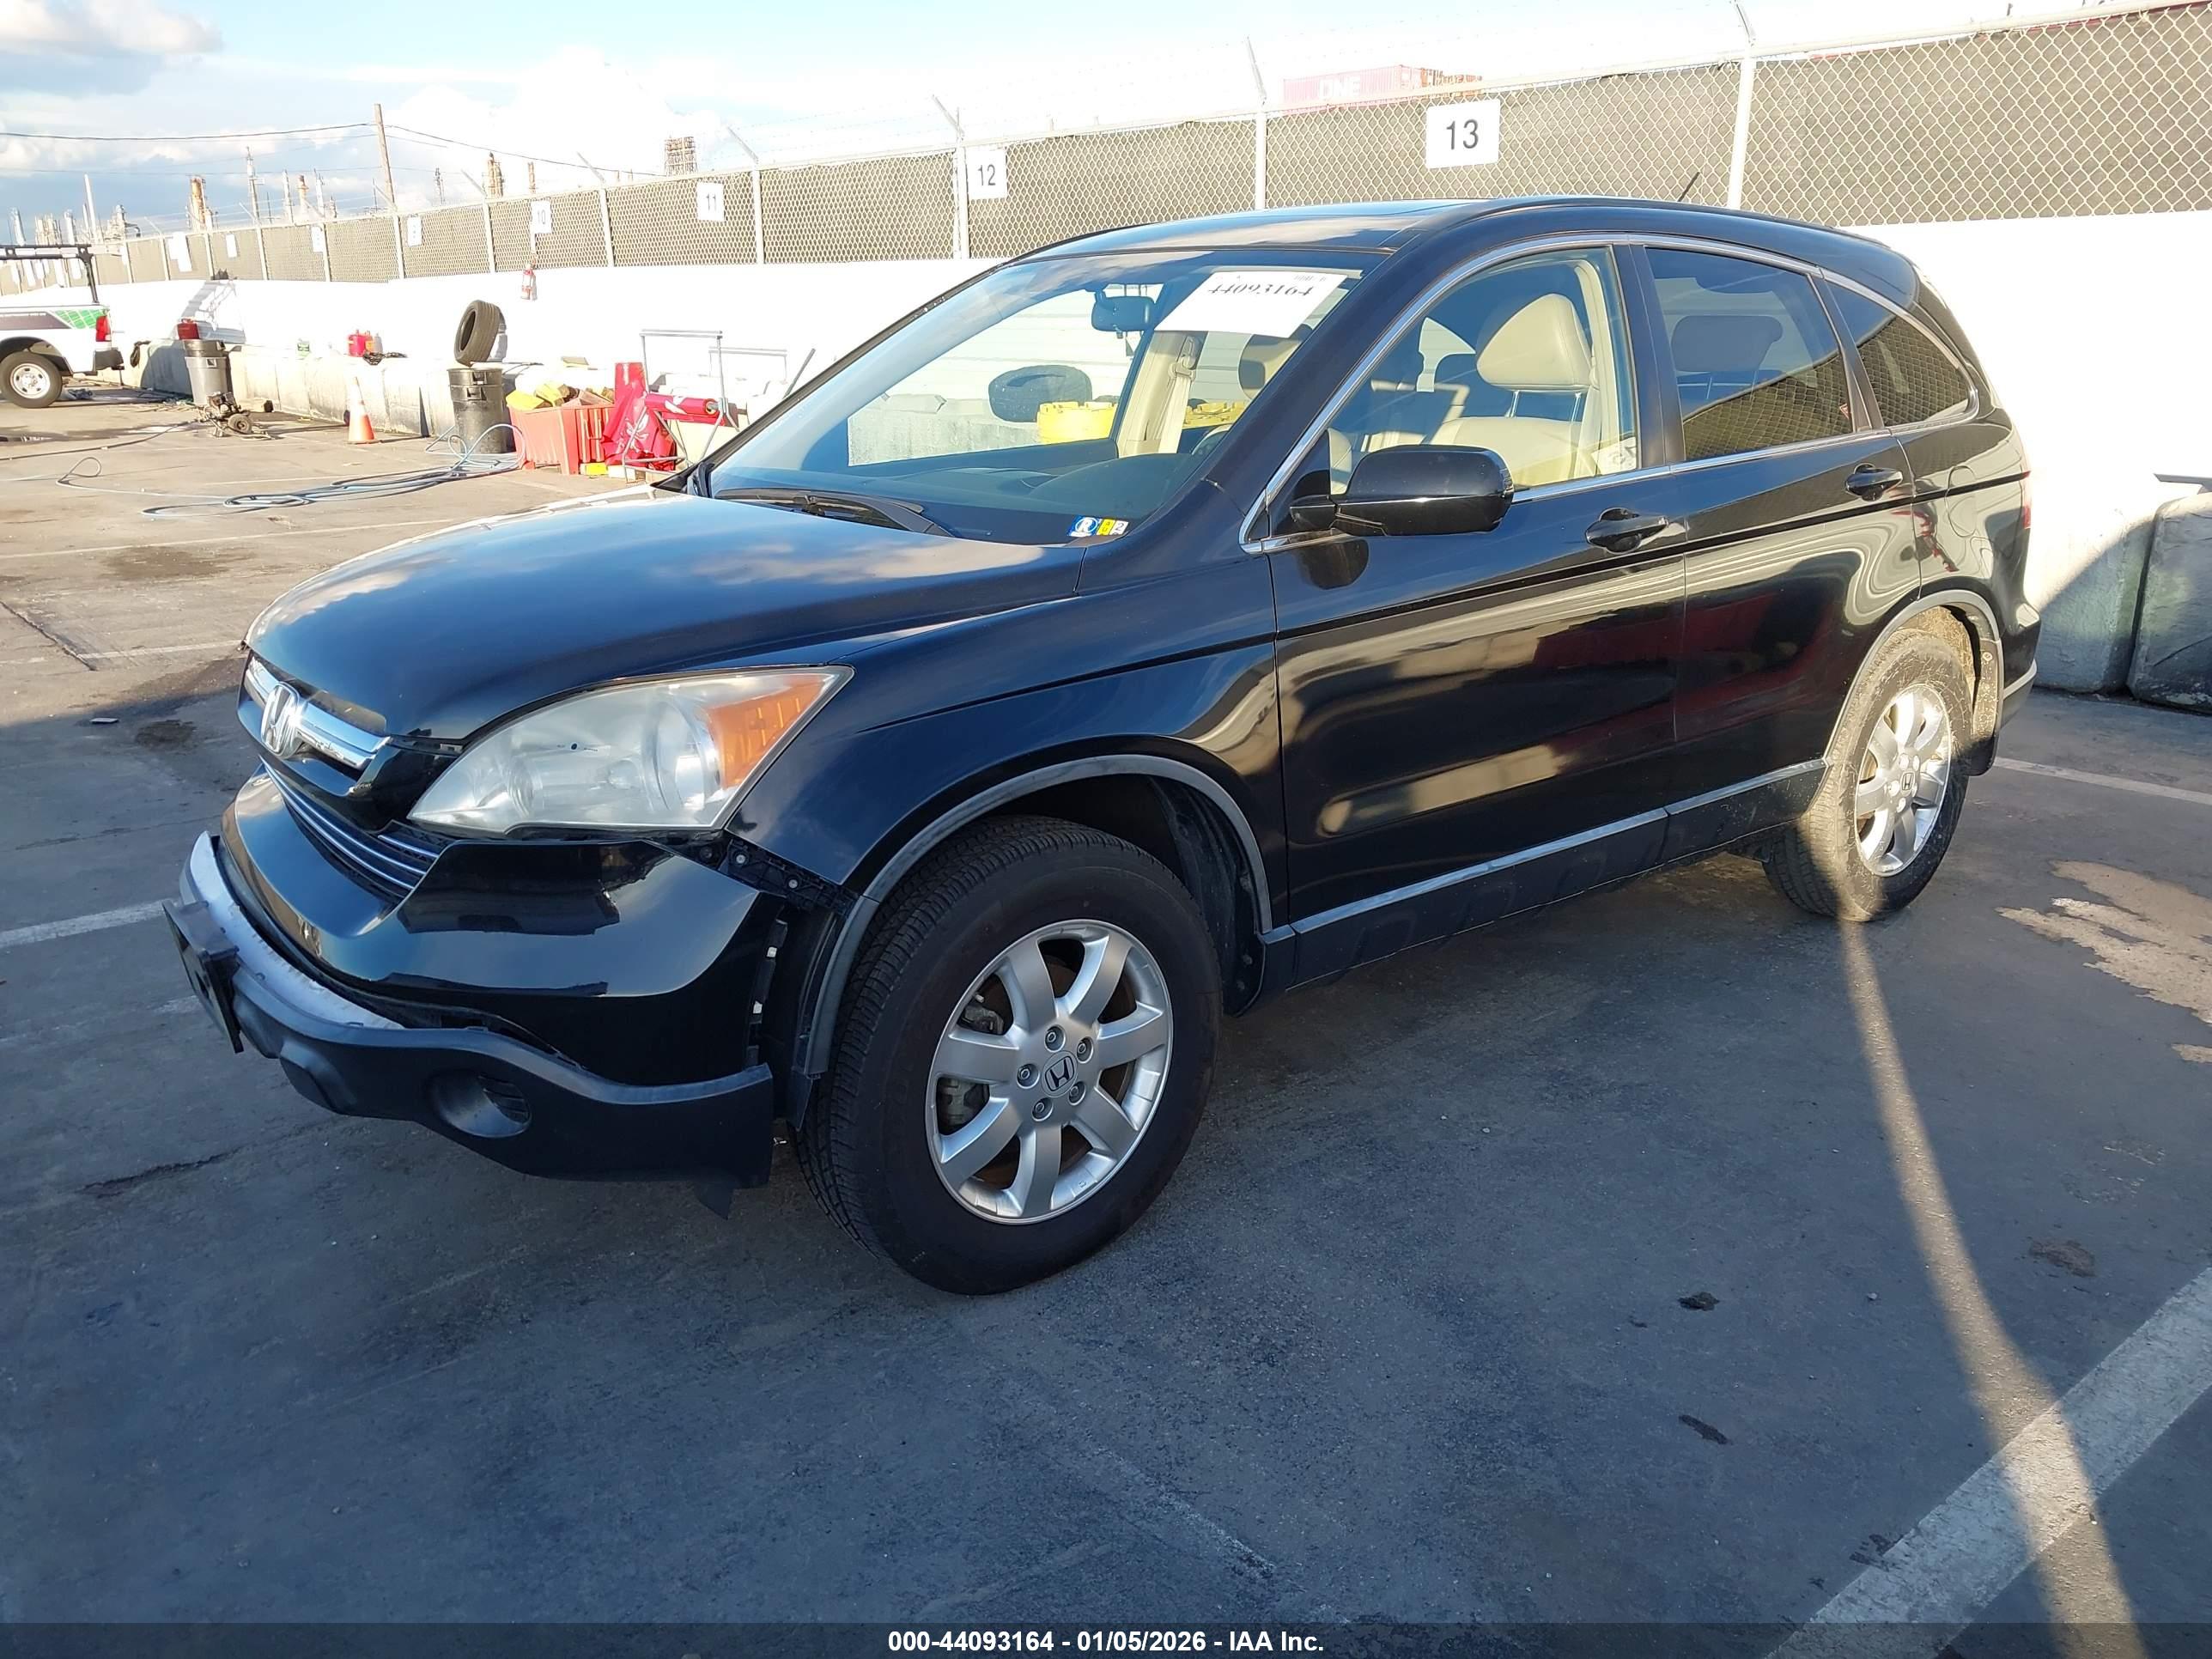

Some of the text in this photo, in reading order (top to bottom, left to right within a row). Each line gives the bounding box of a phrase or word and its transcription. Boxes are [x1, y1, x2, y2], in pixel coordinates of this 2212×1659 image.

[1319, 76, 1360, 100] ONE
[1446, 118, 1479, 150] 13
[977, 164, 996, 186] 12
[705, 193, 718, 211] 11
[537, 209, 546, 225] 10
[1208, 283, 1314, 296] 44093164
